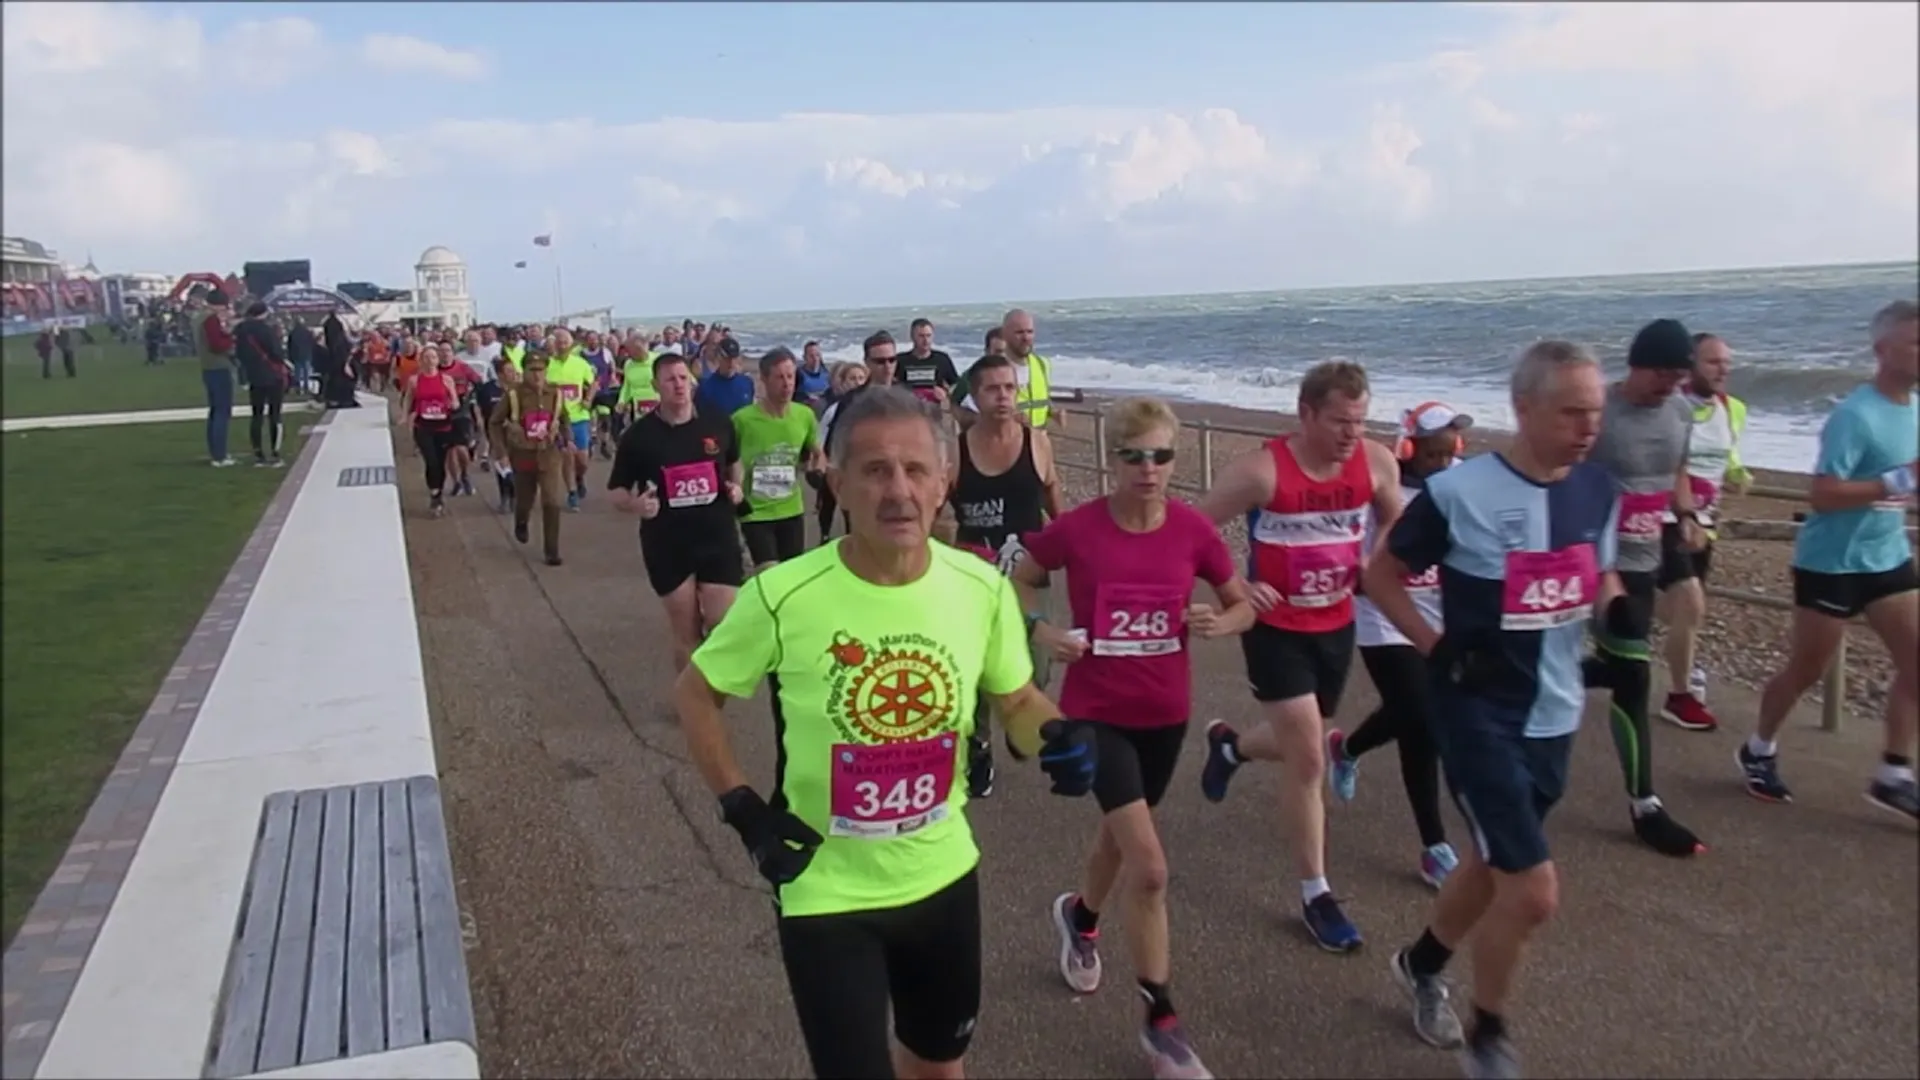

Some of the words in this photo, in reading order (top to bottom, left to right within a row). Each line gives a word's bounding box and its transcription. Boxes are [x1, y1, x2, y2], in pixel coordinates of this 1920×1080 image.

[674, 477, 710, 497] 263
[1300, 566, 1348, 593] 257
[1519, 576, 1585, 610] 484
[1109, 610, 1169, 637] 248
[880, 660, 928, 674] ROTARY
[853, 772, 937, 818] 348
